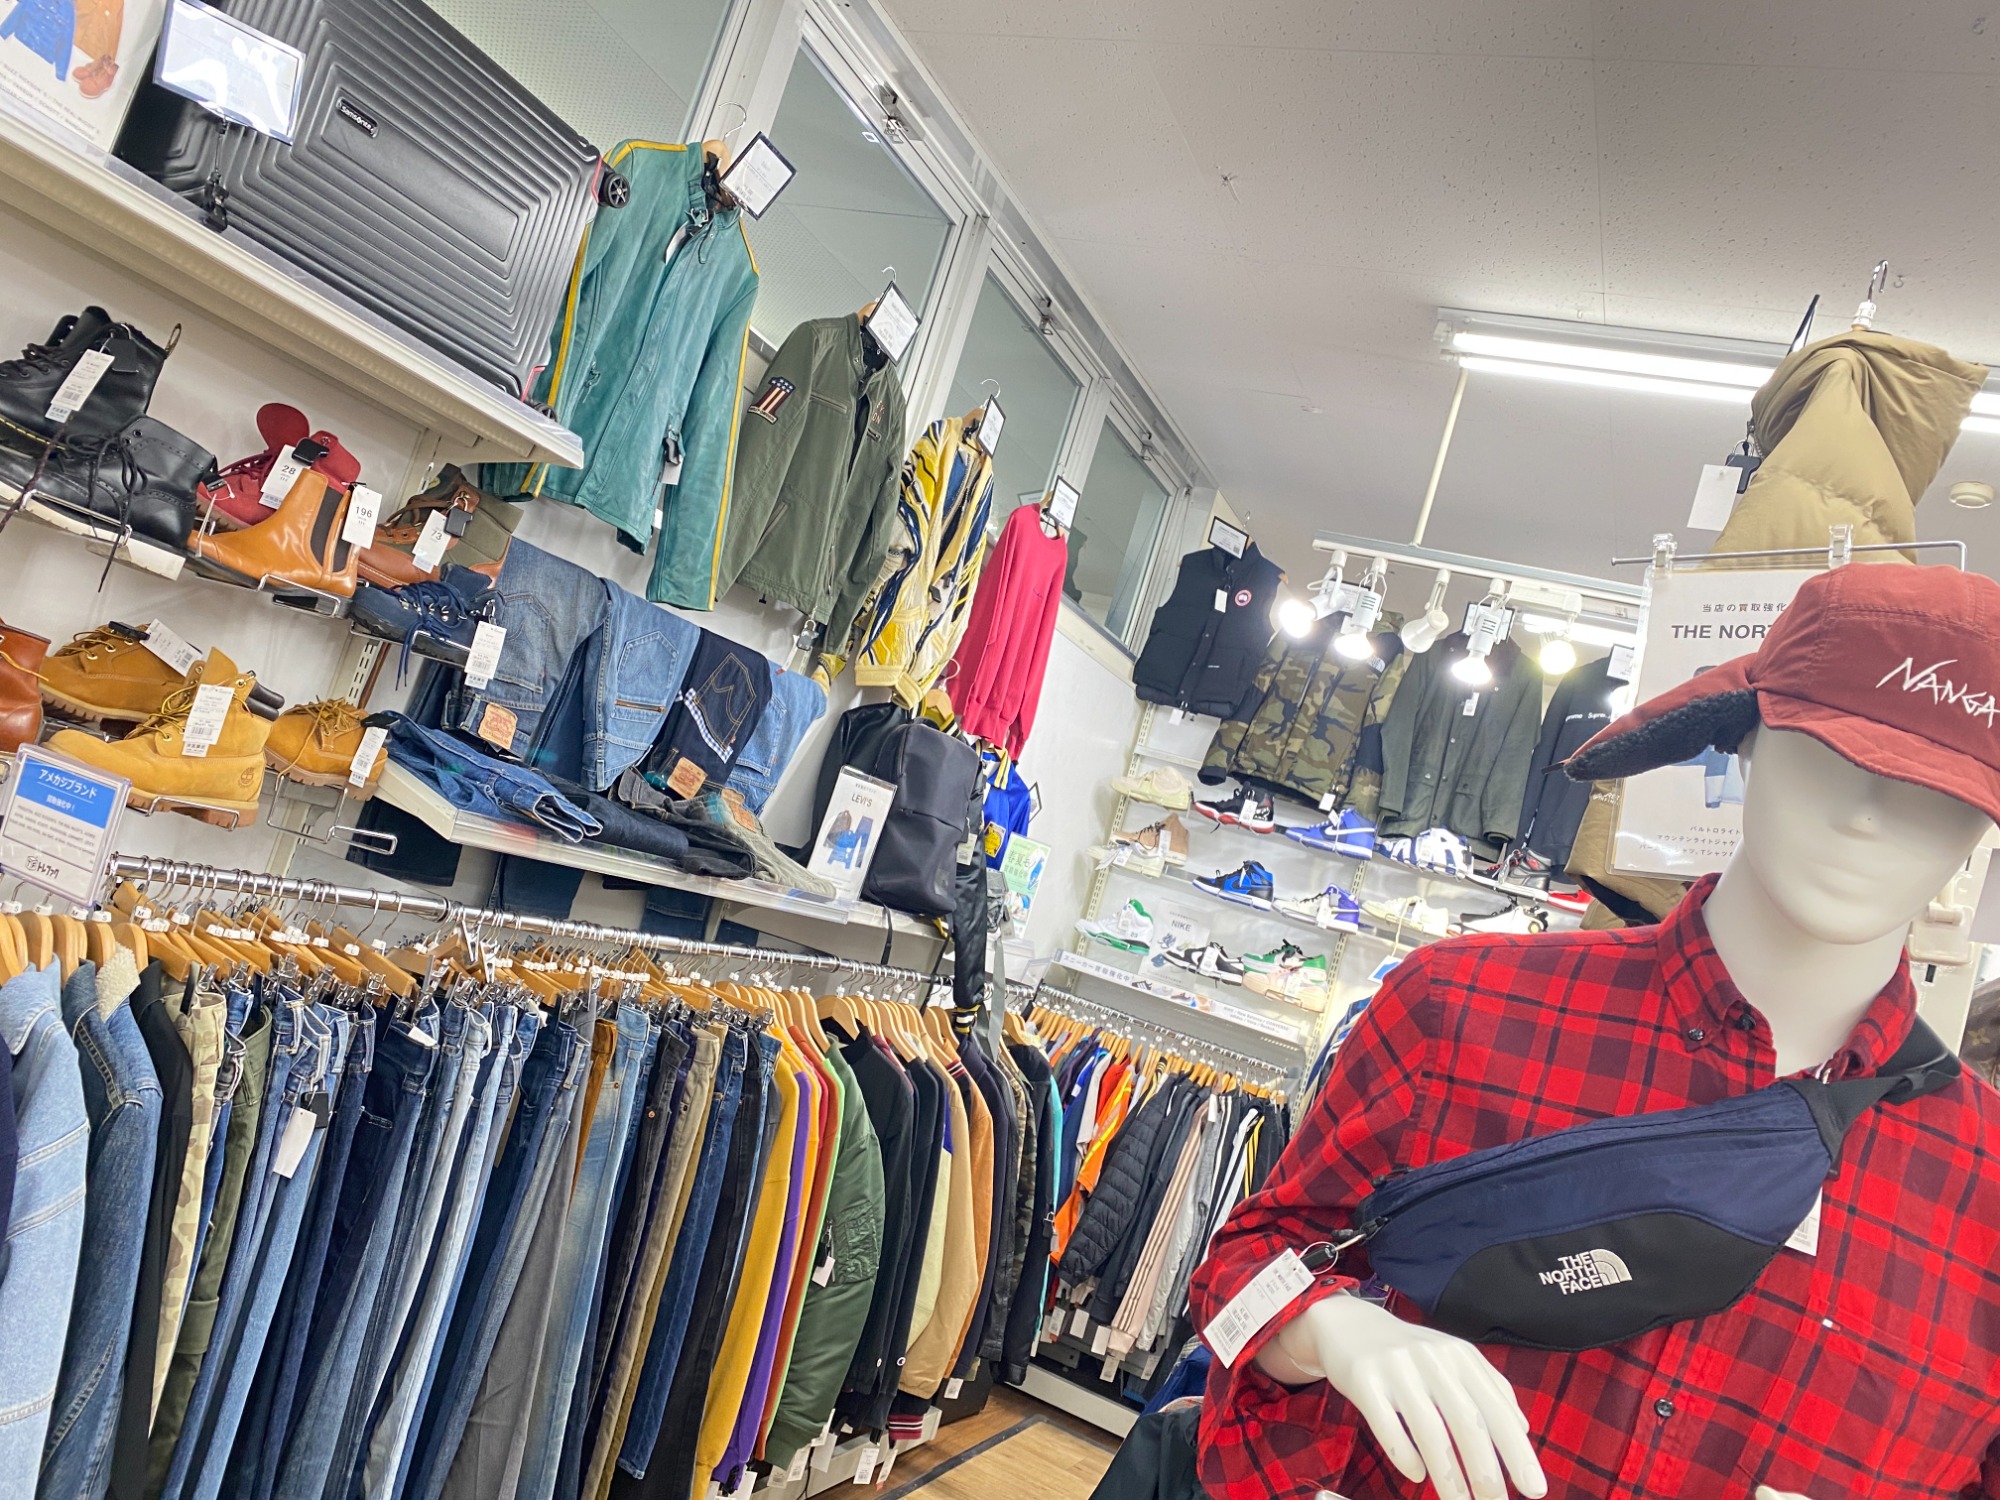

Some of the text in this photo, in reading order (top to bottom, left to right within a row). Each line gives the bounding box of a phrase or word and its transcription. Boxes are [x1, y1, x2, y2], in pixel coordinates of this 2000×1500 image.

[281, 465, 296, 475] 28
[355, 506, 372, 518] 196
[431, 530, 442, 541] 73
[1671, 624, 1712, 639] THE
[1876, 657, 2000, 728] NANGA
[38, 768, 98, 799] アメカジブランド
[851, 793, 873, 807] LEVI'S
[1171, 920, 1192, 932] NIKE
[1557, 1251, 1593, 1269] THE
[1538, 1263, 1598, 1286] NORTH
[1559, 1274, 1603, 1295] FACE
